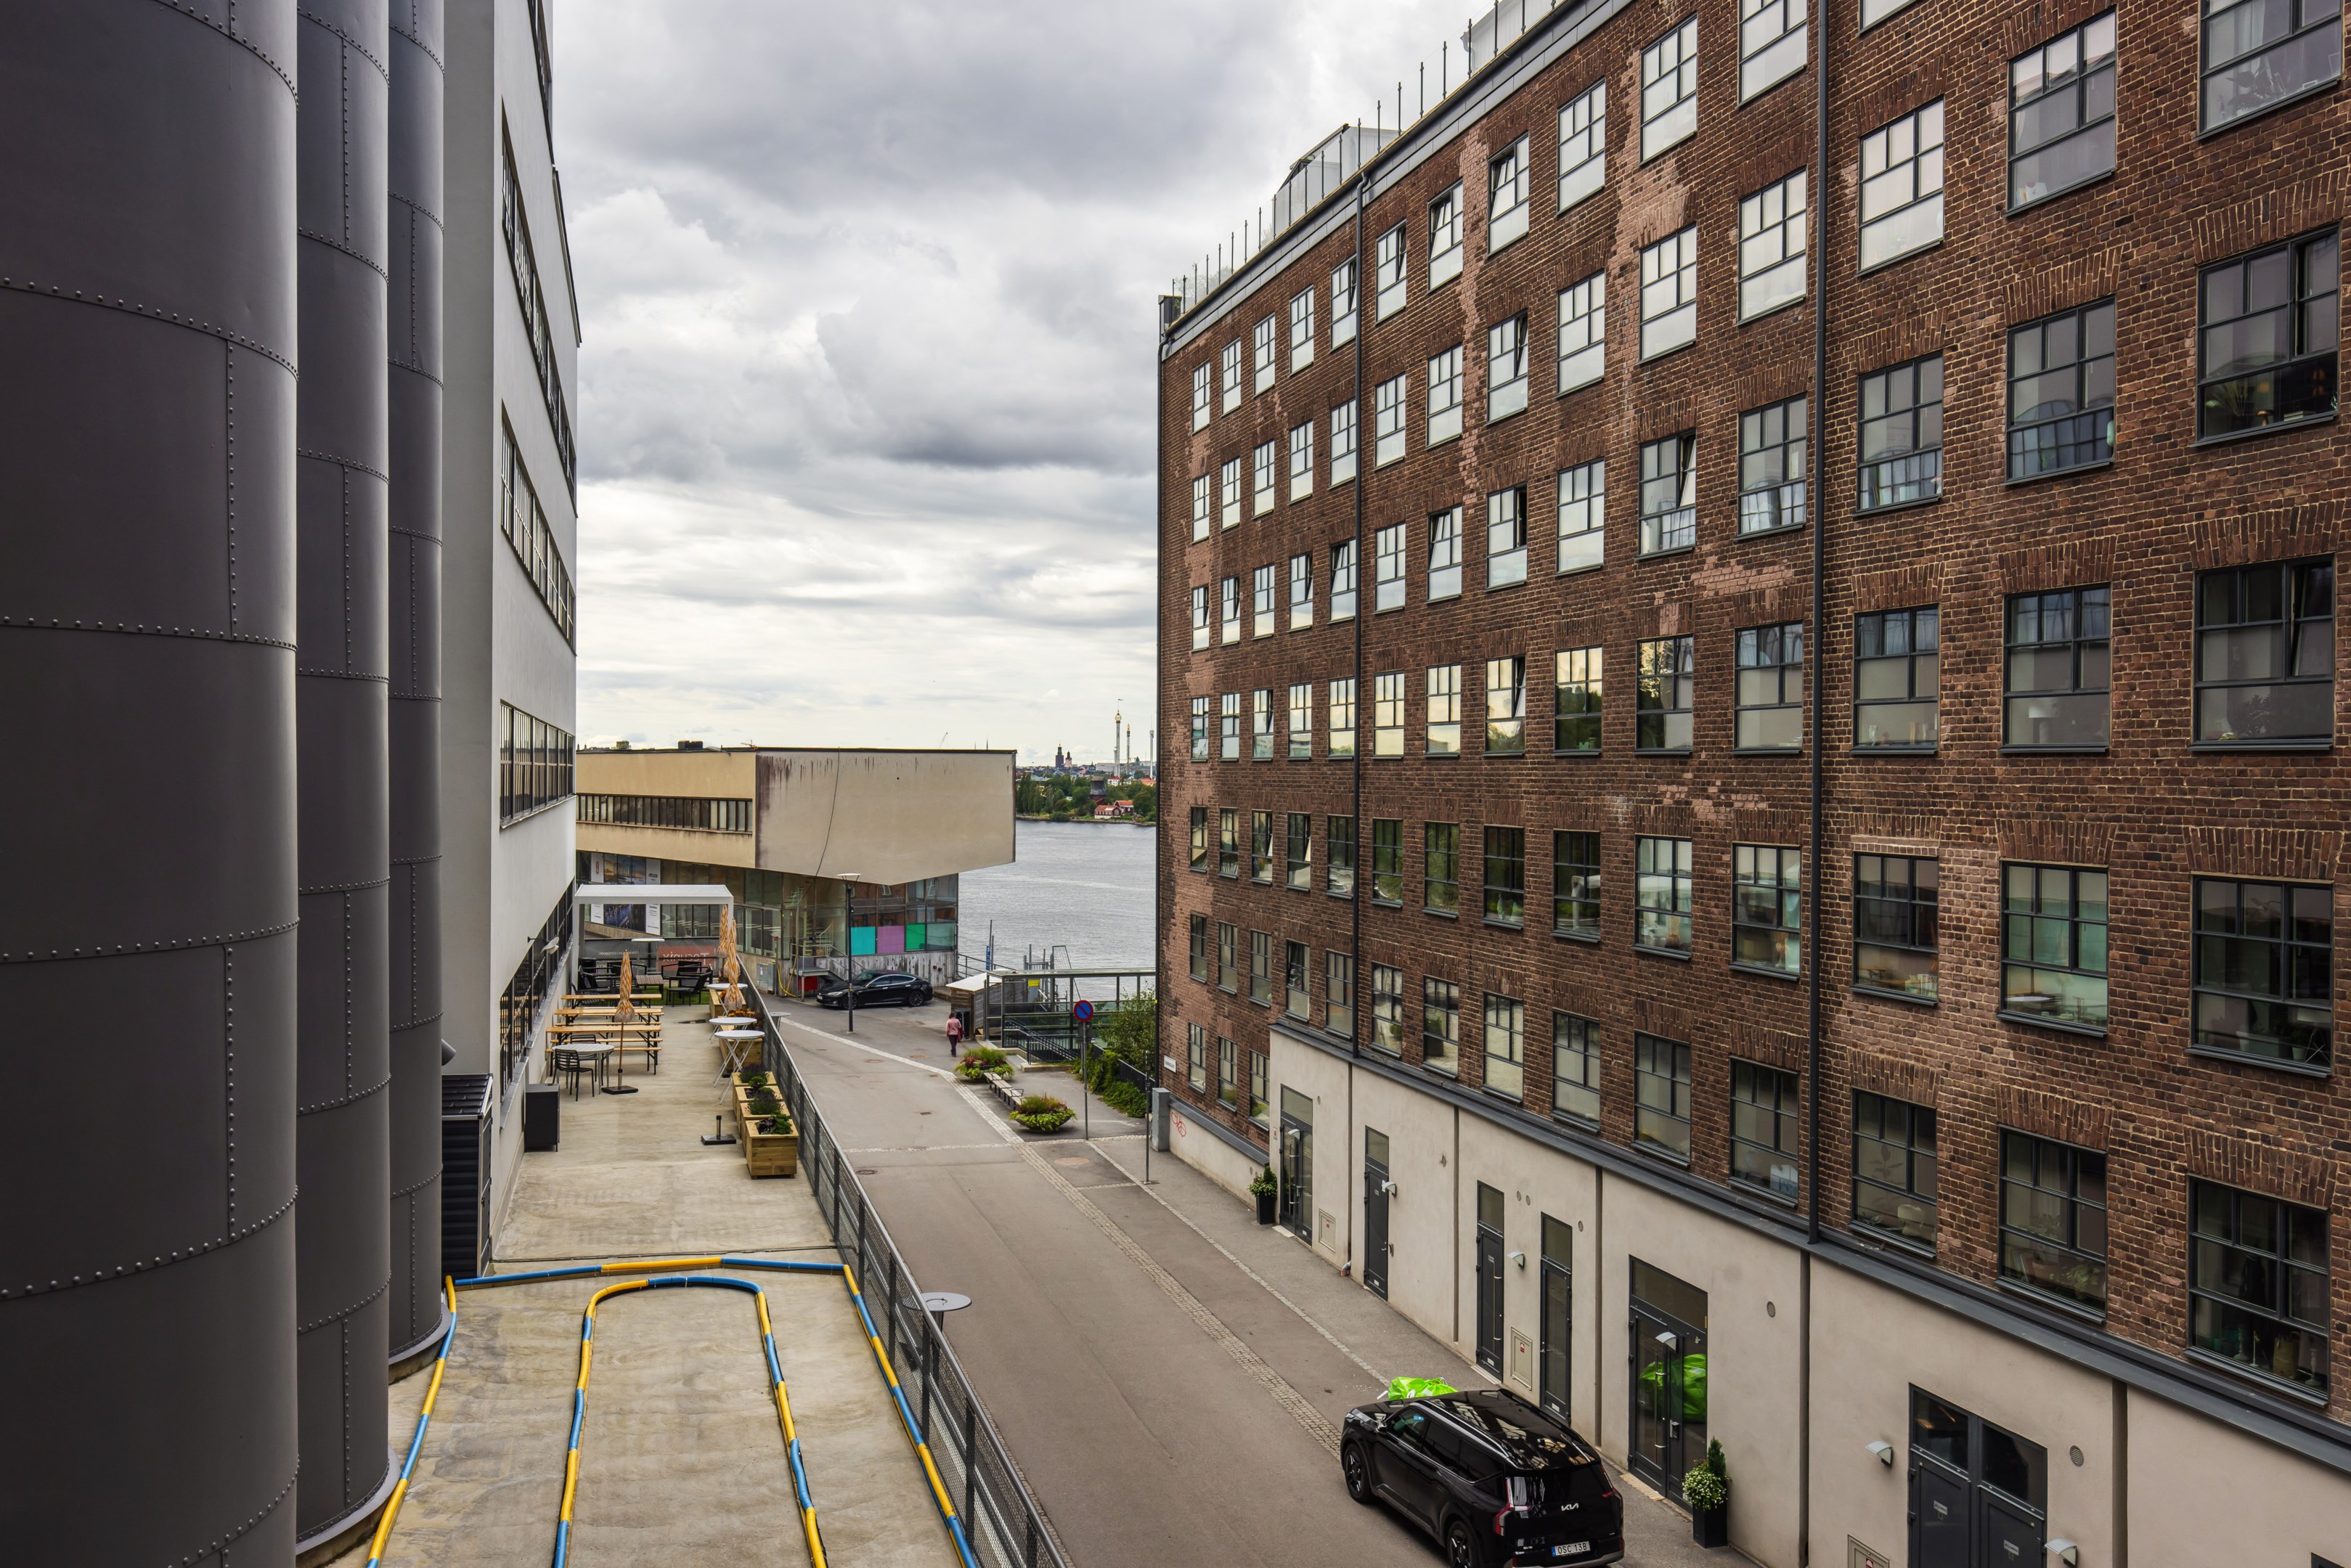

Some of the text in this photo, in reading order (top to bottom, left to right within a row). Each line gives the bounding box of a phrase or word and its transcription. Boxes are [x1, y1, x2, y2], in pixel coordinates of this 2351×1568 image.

[1561, 1503, 1579, 1511] KIA
[1557, 1545, 1572, 1554] OSC
[1574, 1543, 1587, 1551] 13B
